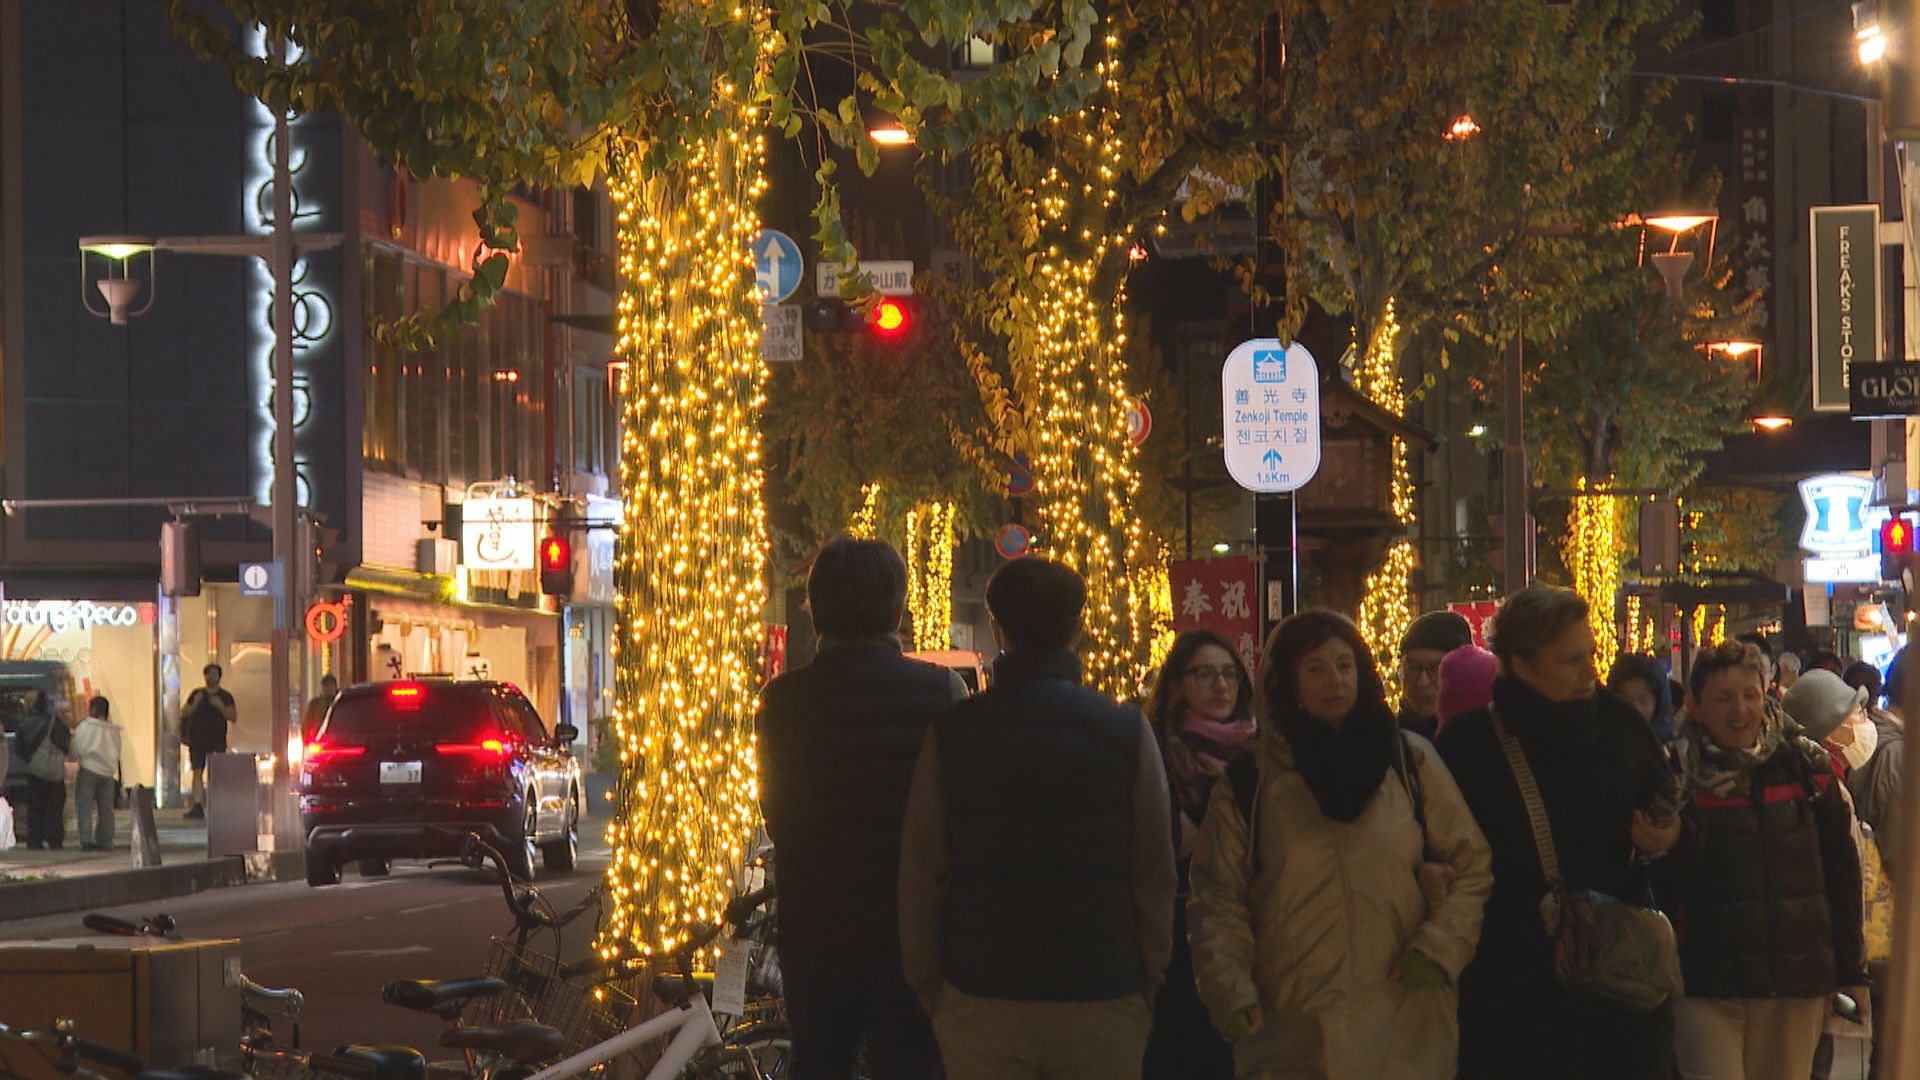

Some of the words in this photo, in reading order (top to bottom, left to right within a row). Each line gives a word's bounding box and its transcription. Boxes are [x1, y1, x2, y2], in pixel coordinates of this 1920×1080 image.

[1235, 388, 1308, 405] 善光寺
[1235, 409, 1270, 425] Zenkoji
[1273, 409, 1308, 425] Temple
